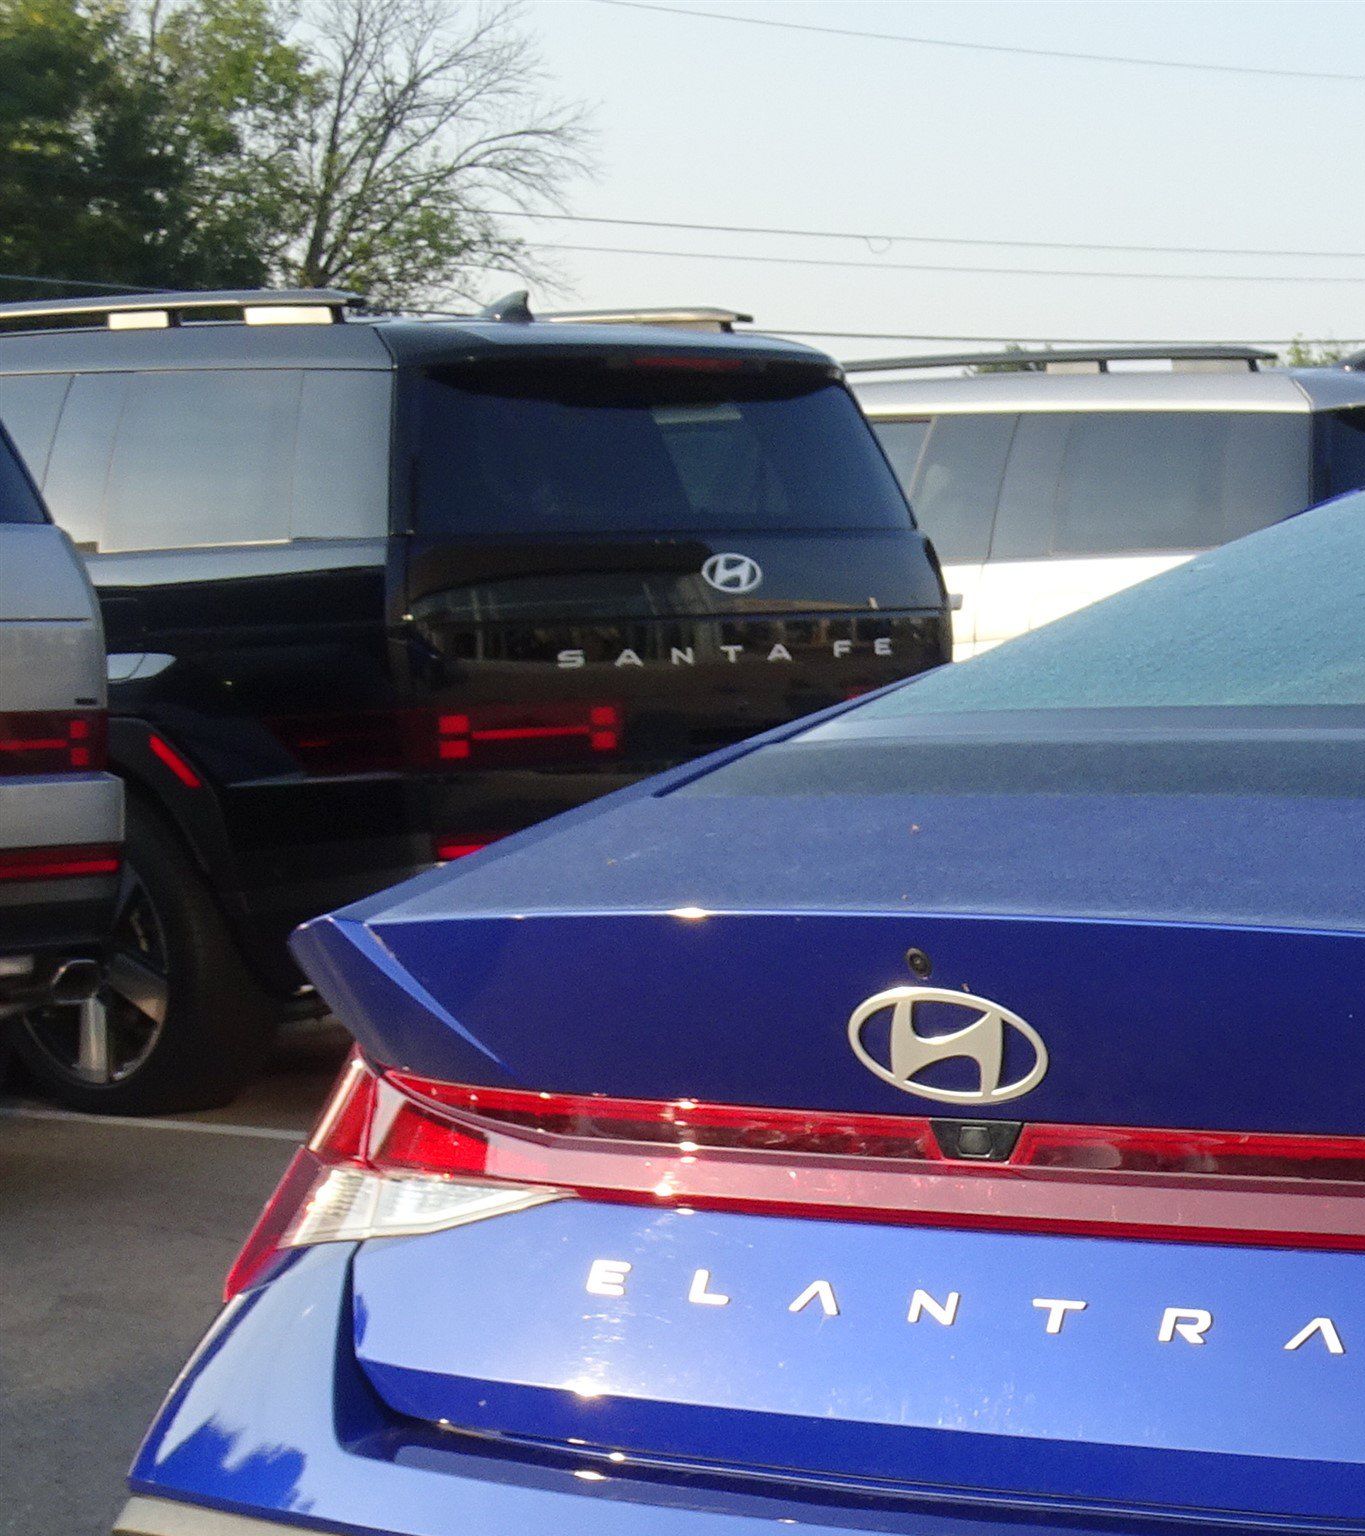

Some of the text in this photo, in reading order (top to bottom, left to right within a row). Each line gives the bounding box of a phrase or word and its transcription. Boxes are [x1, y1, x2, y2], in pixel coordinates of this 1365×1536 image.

[557, 637, 893, 669] SANTA FE
[585, 1259, 1346, 1355] ELANTRA
